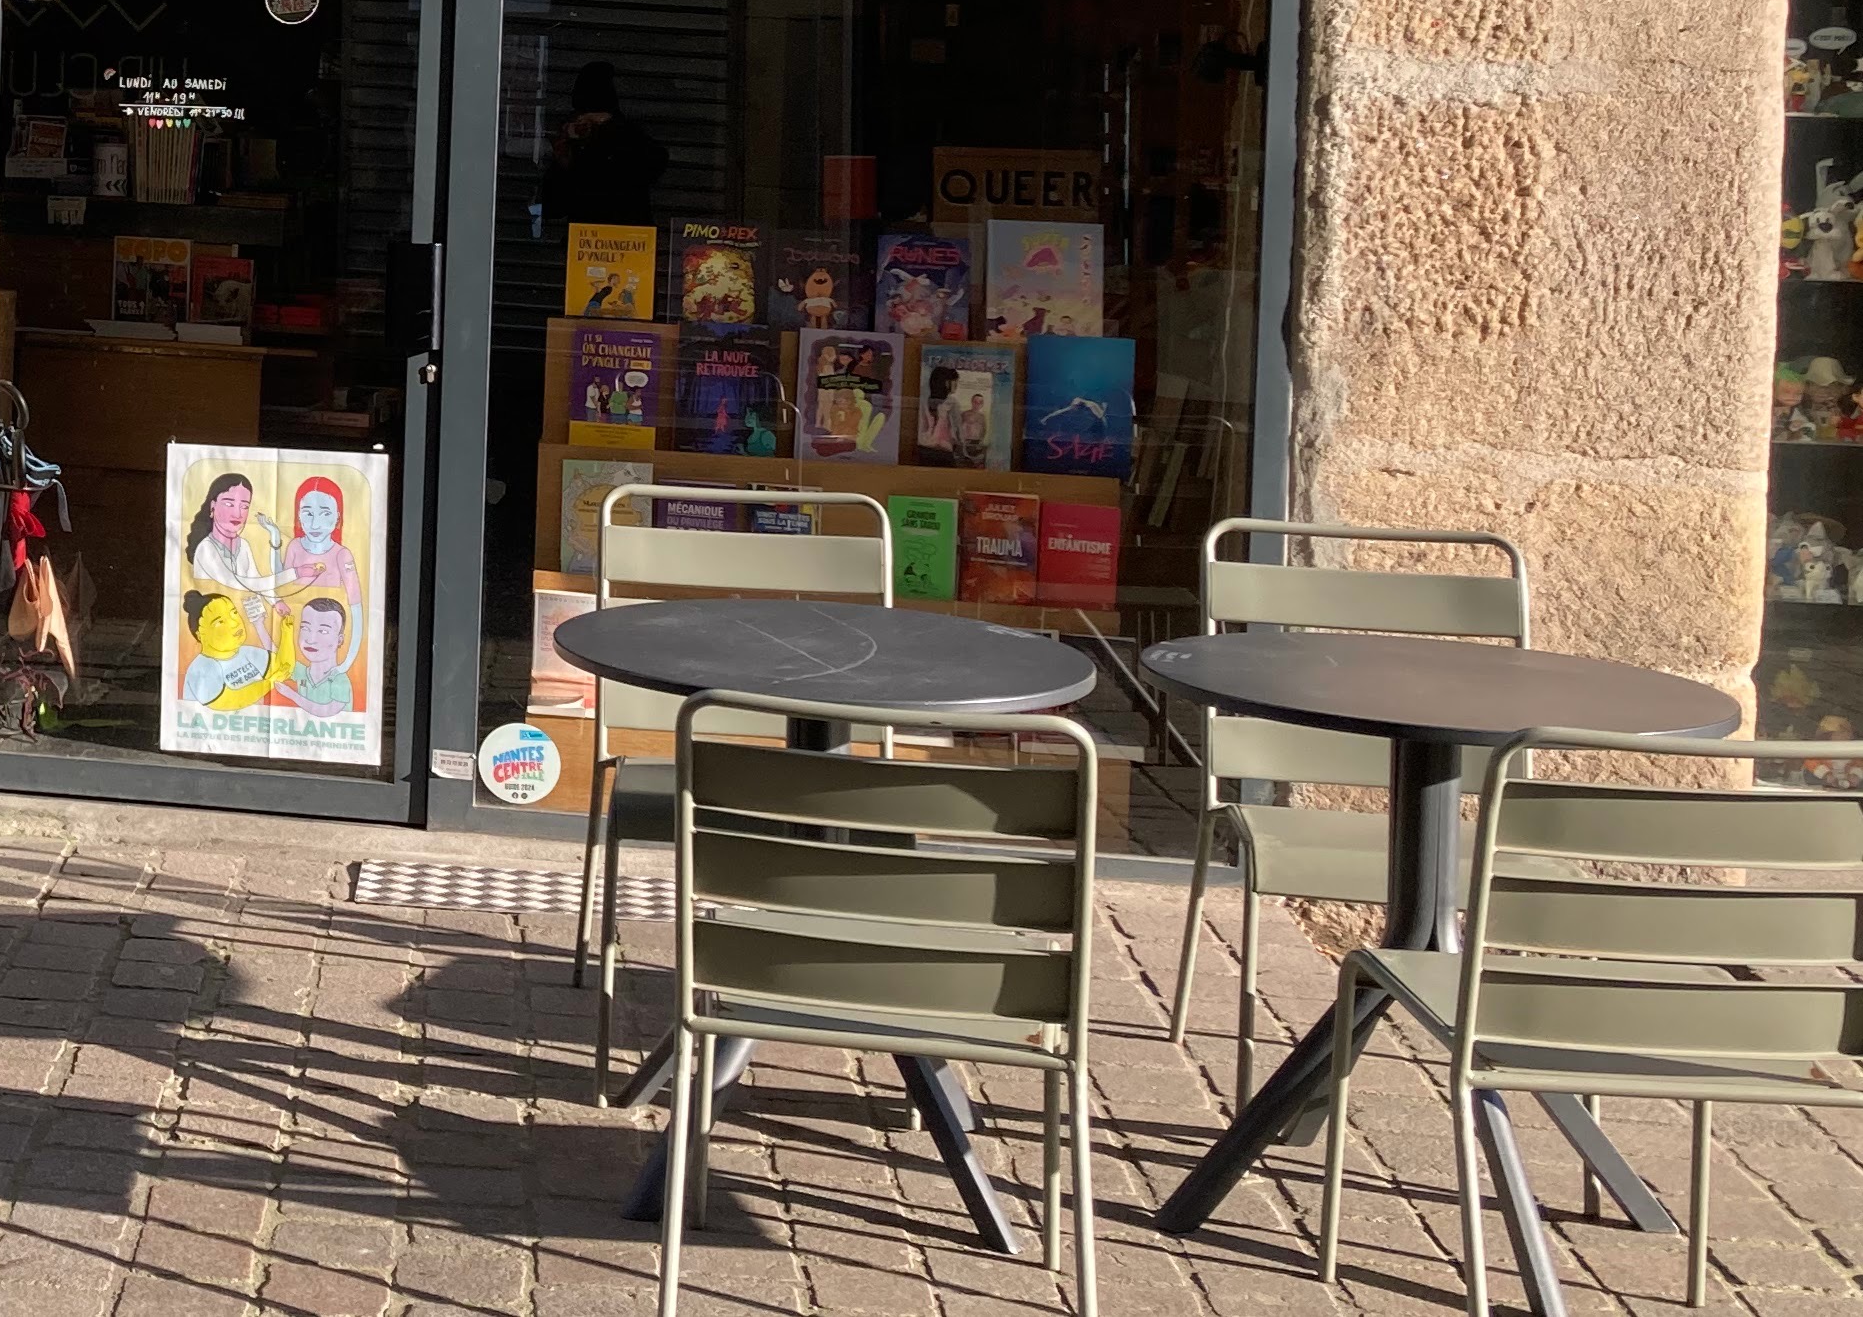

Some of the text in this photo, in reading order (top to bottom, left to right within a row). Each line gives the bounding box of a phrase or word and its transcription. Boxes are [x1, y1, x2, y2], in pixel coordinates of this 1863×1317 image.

[119, 73, 228, 91] LUNDI AU SAMEDI
[137, 105, 185, 117] VENDREDI
[940, 165, 1095, 208] QUEER
[683, 225, 720, 239] PIMO
[579, 239, 647, 252] ON CHANGEAIT
[582, 343, 652, 358] ON CHANGEAIT
[704, 349, 752, 363] LA NUIT
[696, 363, 761, 378] RETROUVÉE
[667, 501, 725, 518] MÉCANIQUE
[682, 517, 725, 530] PRIVILÈGE
[976, 535, 1024, 558] TRAUMA
[176, 711, 209, 732] LA
[176, 730, 189, 739] LA
[223, 733, 242, 743] DES
[492, 744, 545, 767] NANTES
[492, 761, 544, 784] CENTRE
